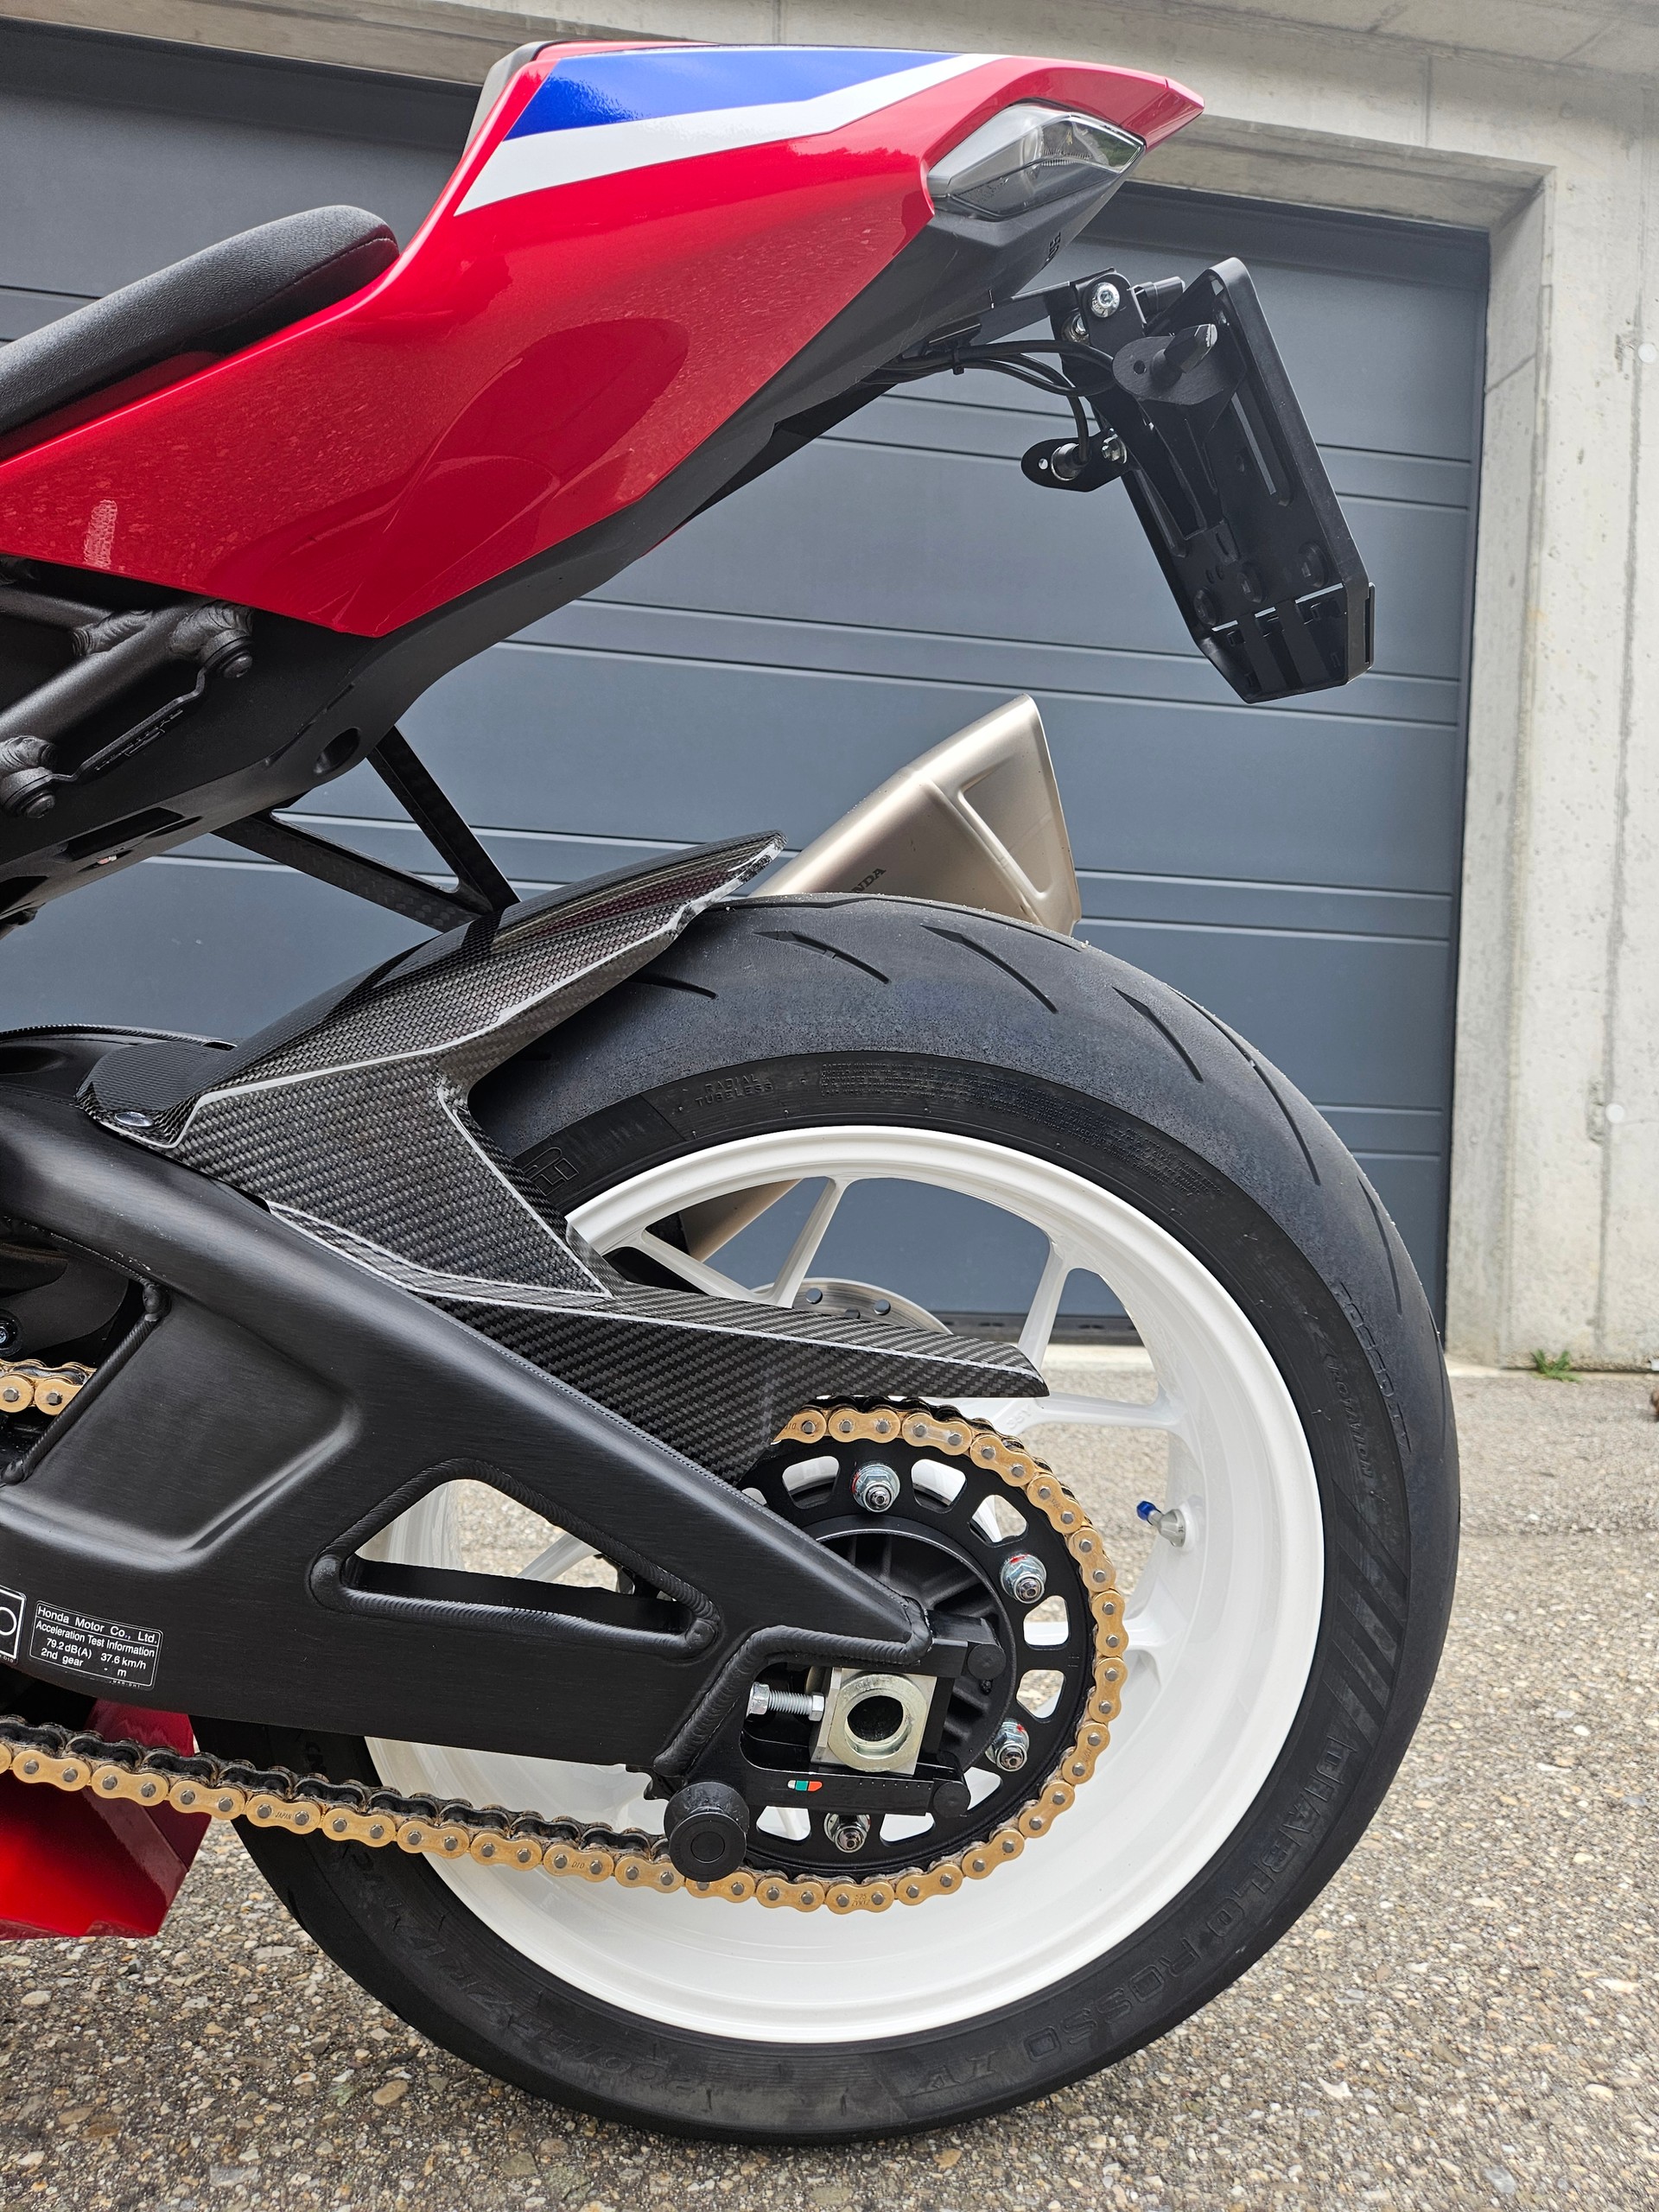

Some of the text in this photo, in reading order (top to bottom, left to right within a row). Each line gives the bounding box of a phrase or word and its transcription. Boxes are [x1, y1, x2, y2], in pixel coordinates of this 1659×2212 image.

[695, 1081, 773, 1107] TUBELESS
[704, 1073, 759, 1092] RADIAL
[36, 1620, 155, 1657] Acceleration Test Information
[37, 1606, 69, 1624] Honda
[75, 1617, 105, 1632] Motor
[138, 1631, 156, 1643] Ltd.
[41, 1648, 57, 1660] 2nd
[62, 1654, 83, 1667] gear
[100, 1653, 120, 1664] 37.6
[122, 1658, 146, 1669] km/h
[1205, 1732, 1358, 1937] DIABLO
[1022, 1937, 1201, 2063] ROSSO
